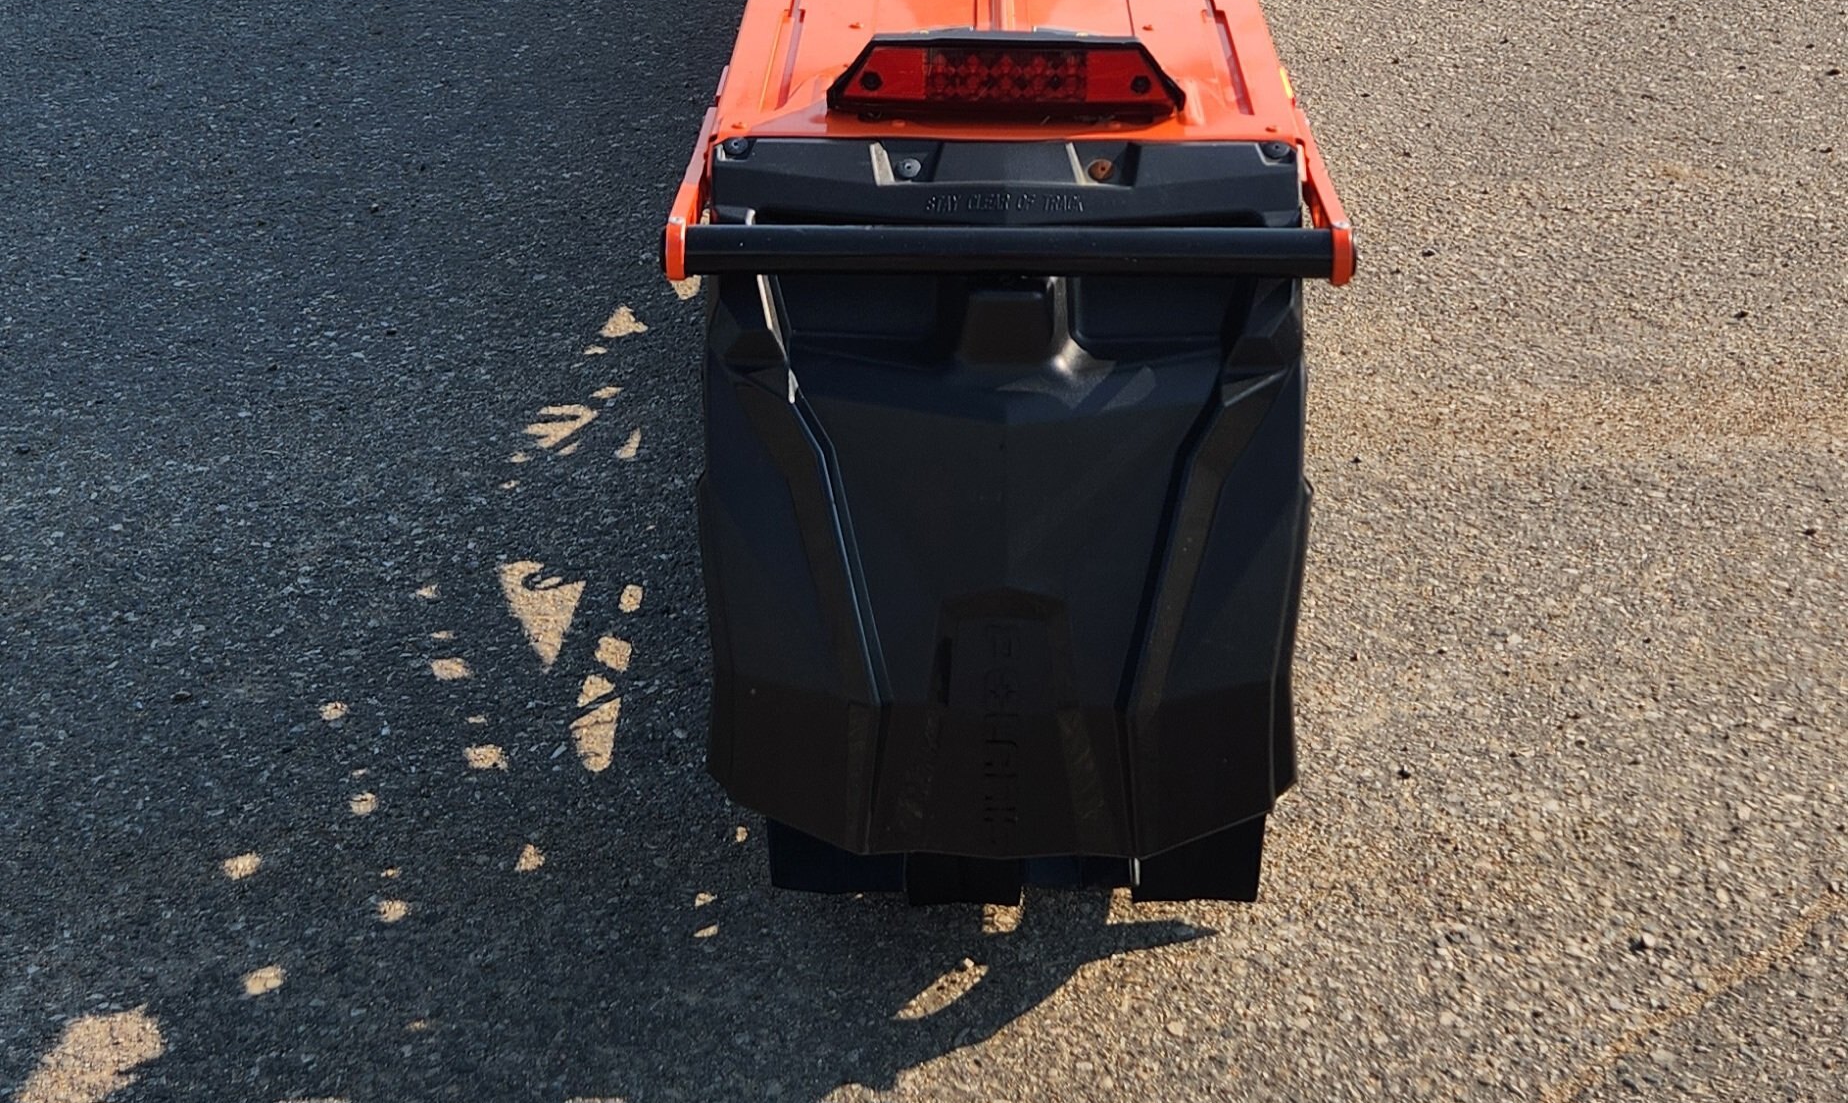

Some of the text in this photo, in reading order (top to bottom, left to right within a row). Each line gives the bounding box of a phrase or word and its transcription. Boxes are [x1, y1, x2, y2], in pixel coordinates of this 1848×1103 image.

[926, 193, 1084, 213] STAY CLEAR OF TRACK
